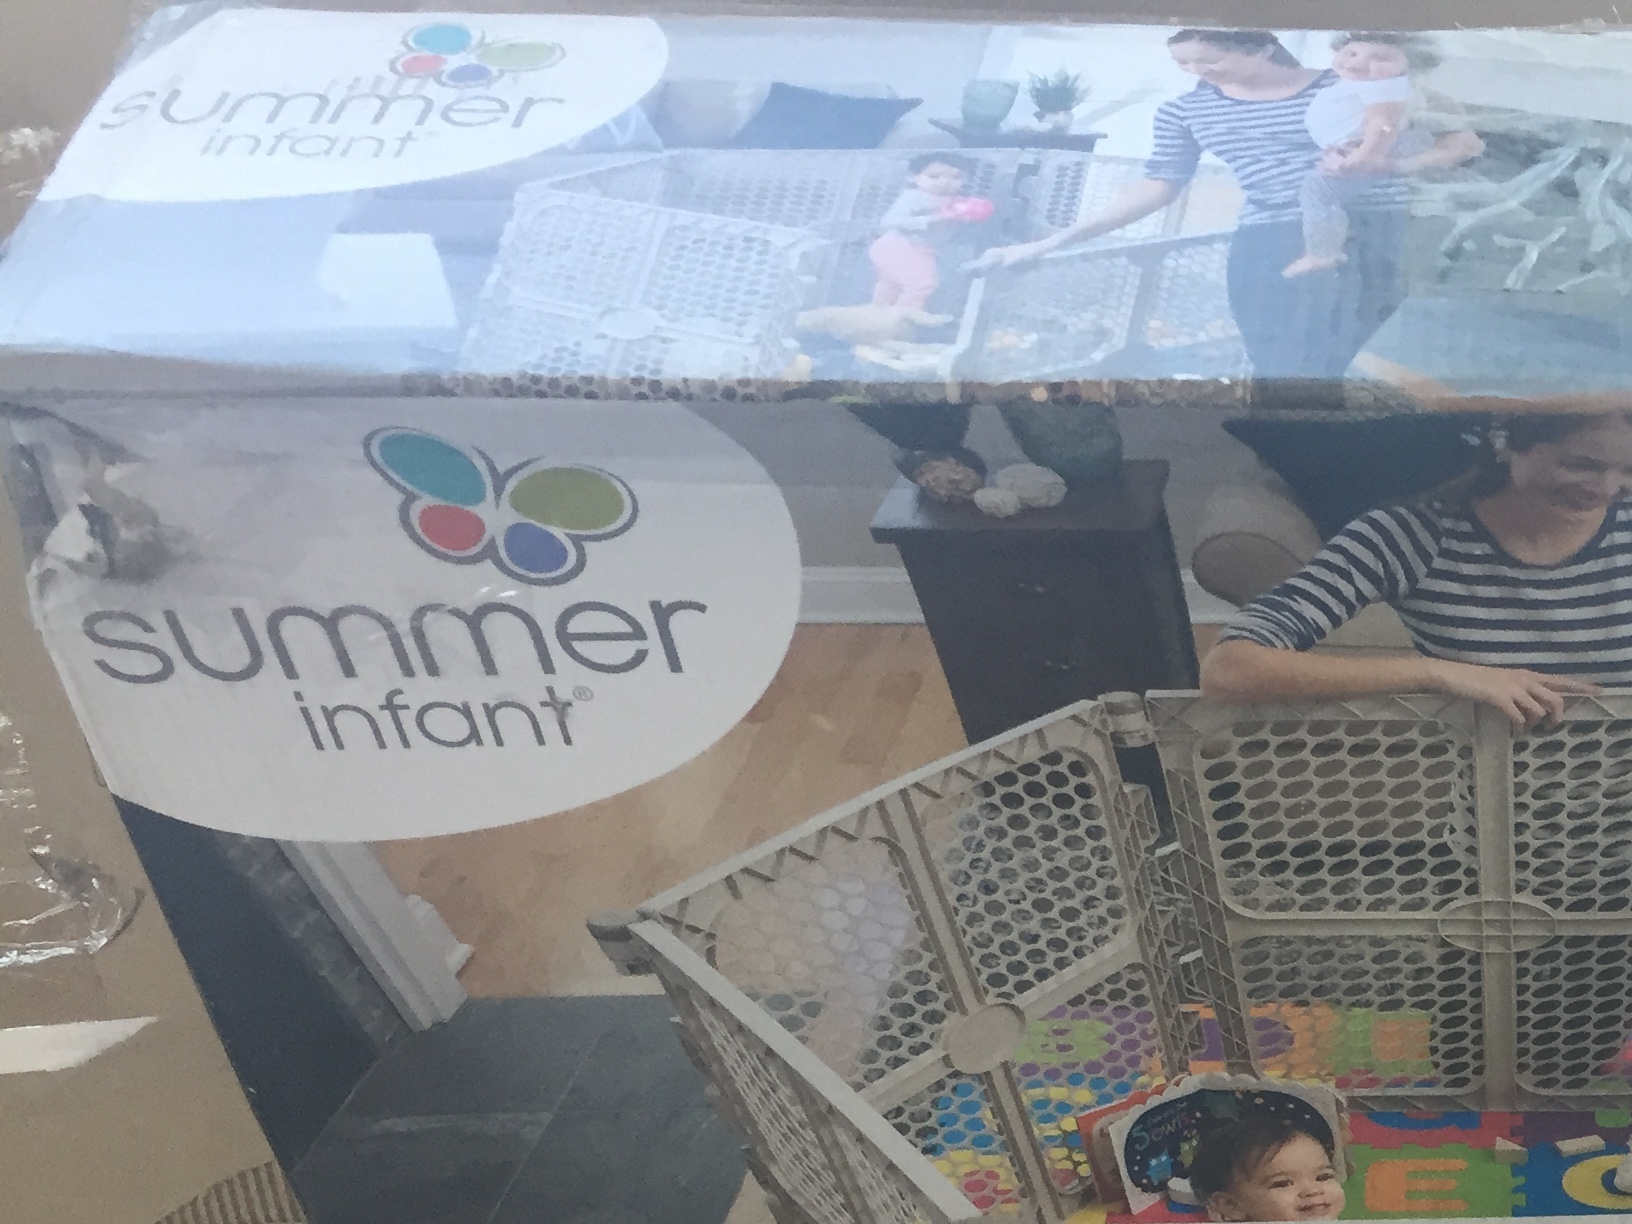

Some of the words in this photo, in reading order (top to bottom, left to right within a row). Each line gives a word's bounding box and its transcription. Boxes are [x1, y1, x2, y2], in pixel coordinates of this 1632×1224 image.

[99, 86, 565, 129] summer
[200, 127, 416, 159] infant
[82, 600, 708, 685] summer
